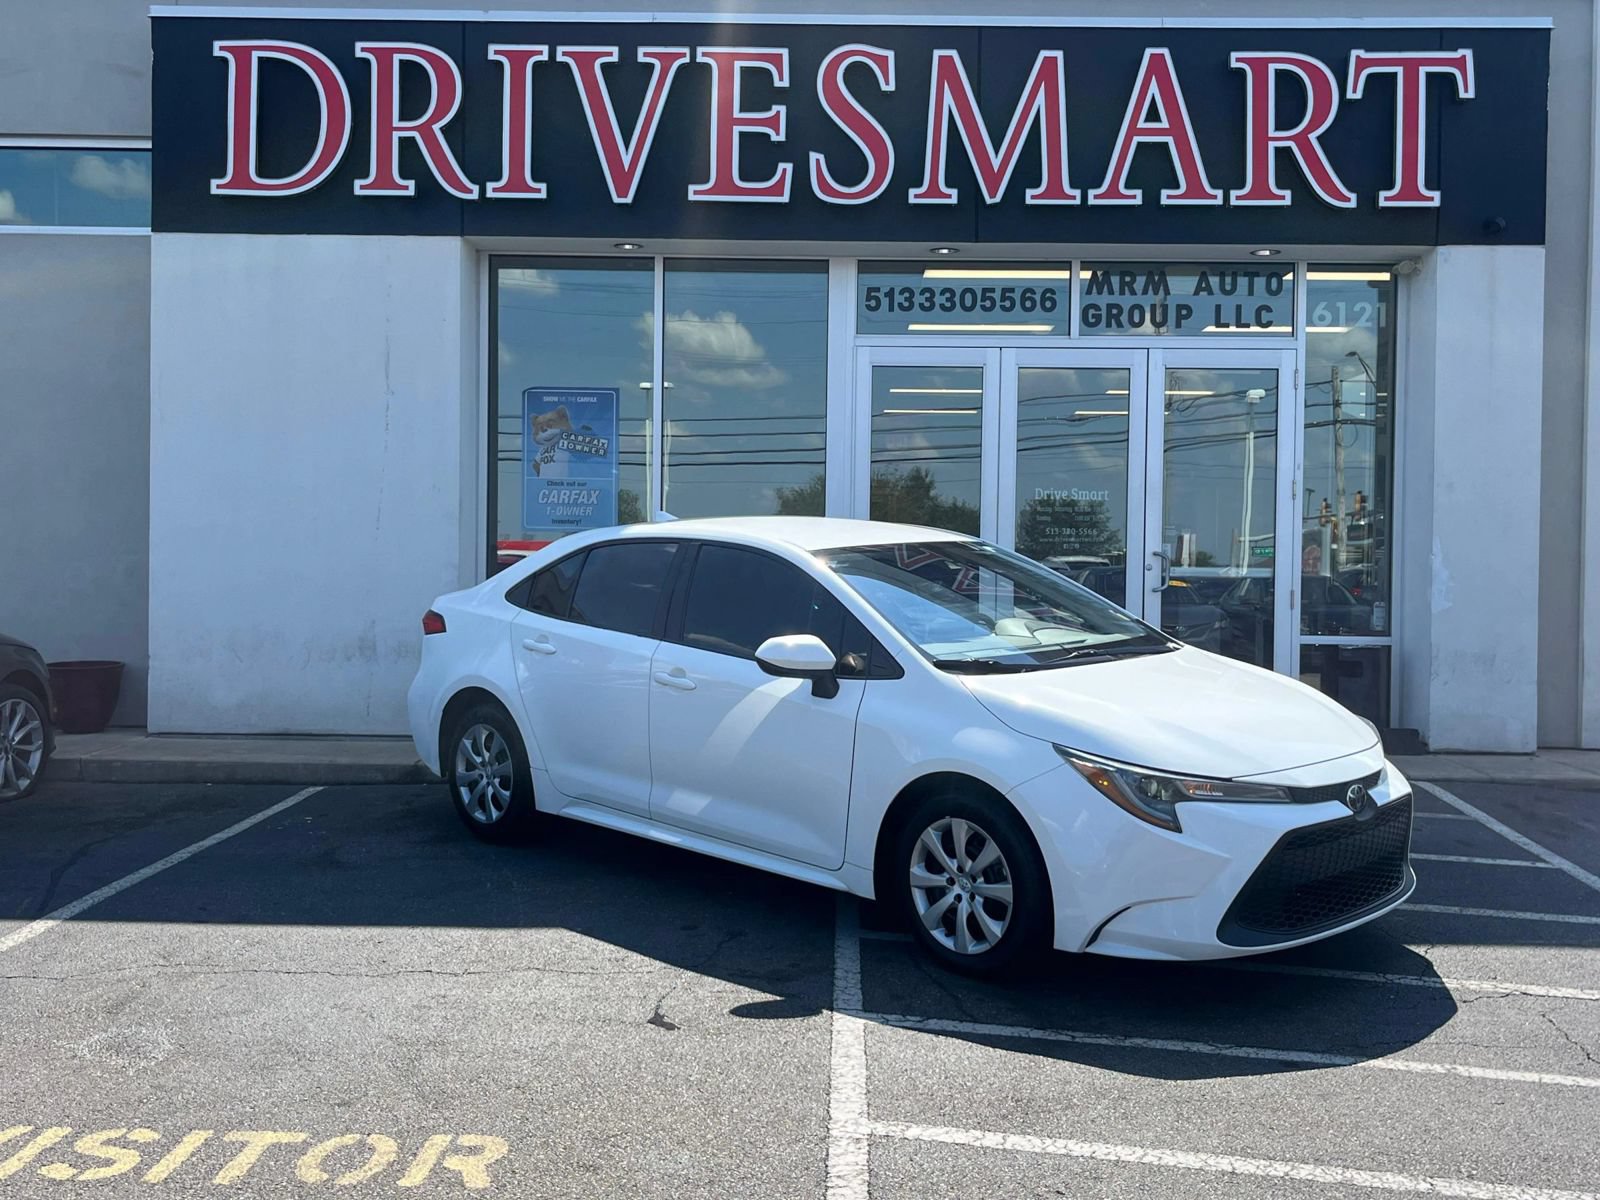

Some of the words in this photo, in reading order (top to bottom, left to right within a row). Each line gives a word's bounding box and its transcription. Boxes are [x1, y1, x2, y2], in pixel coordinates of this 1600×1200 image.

[210, 40, 1476, 208] DRIVESMART
[1085, 270, 1171, 296] MRM
[1193, 270, 1284, 297] AUTO
[865, 286, 1058, 313] 5133305566
[1081, 302, 1193, 329] GROUP
[1214, 303, 1275, 329] LLC
[1312, 301, 1387, 328] 6121
[562, 432, 608, 449] CARFAX
[568, 443, 605, 456] OWNER
[538, 489, 600, 505] CARFAX
[1035, 487, 1068, 501] Drive
[1071, 487, 1110, 501] Smart
[546, 505, 593, 517] 1-OWNER
[0, 1125, 510, 1190] ISITOR
